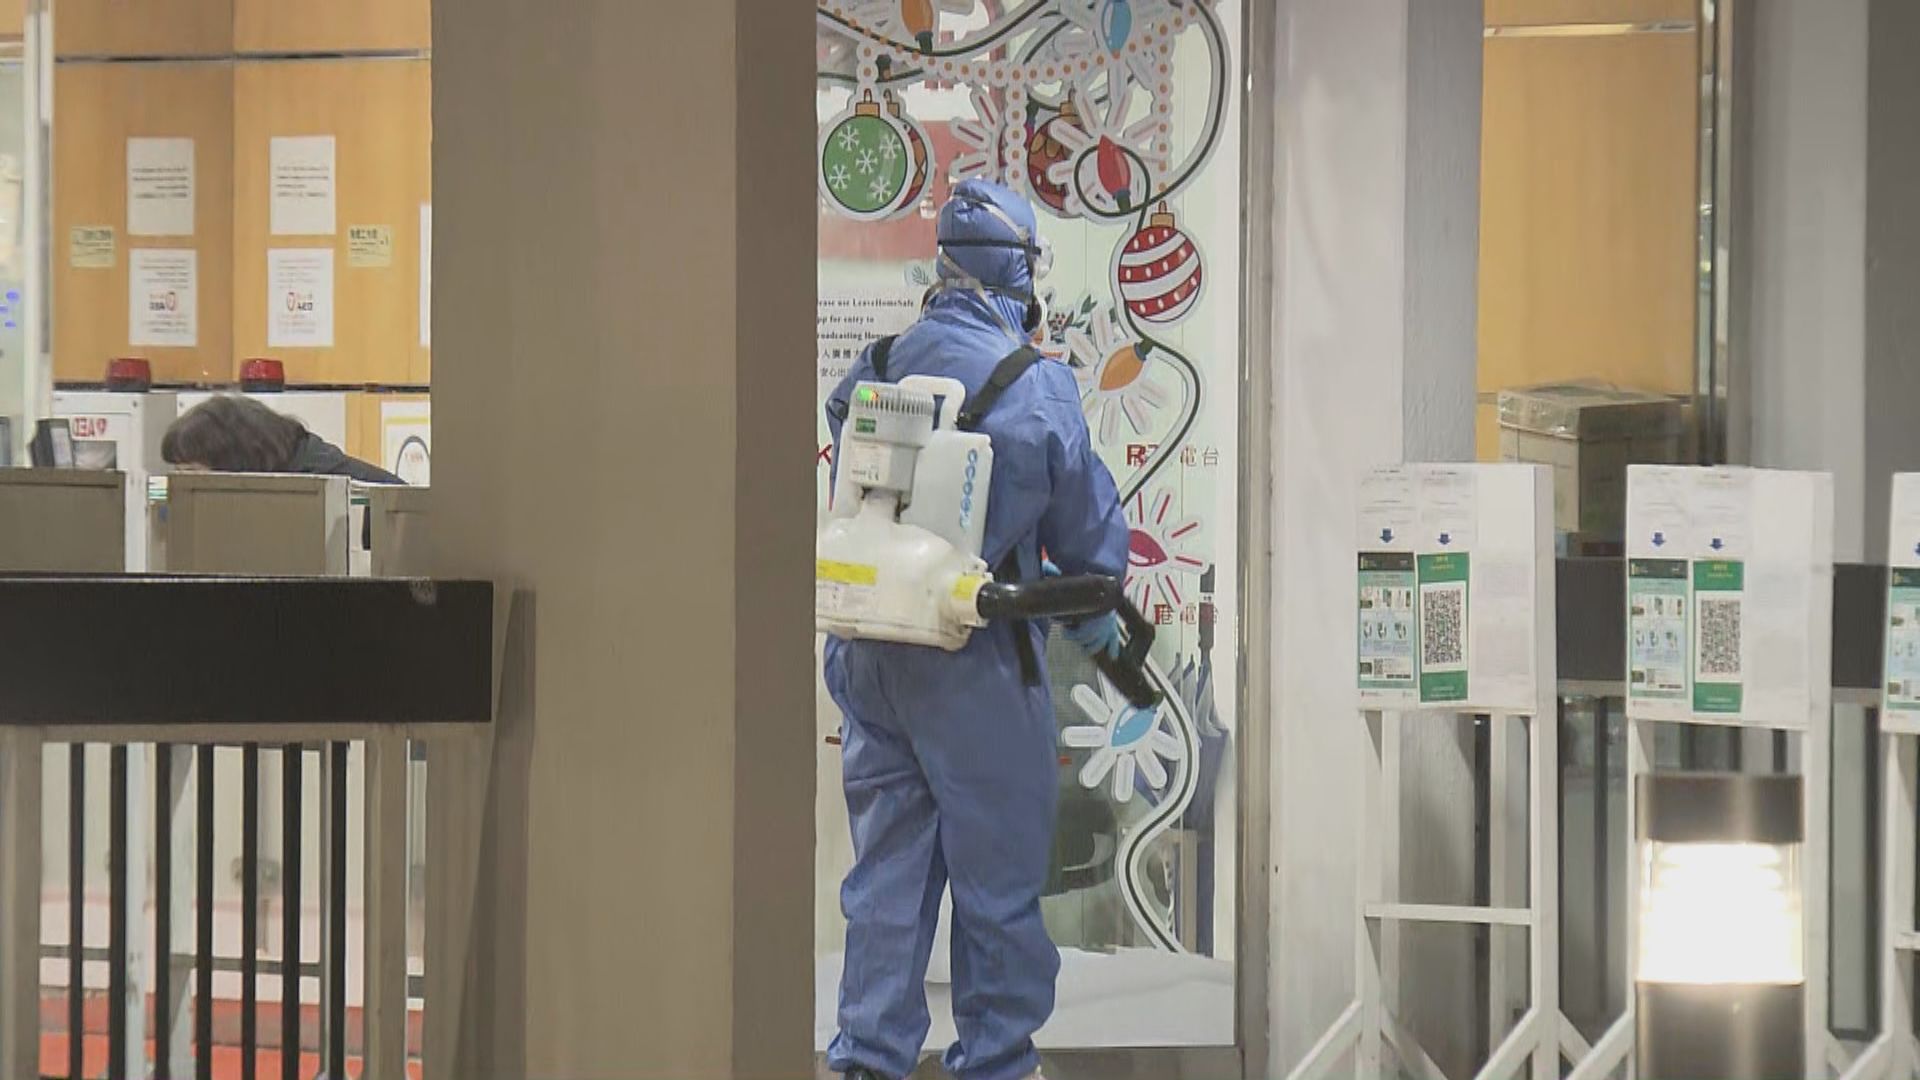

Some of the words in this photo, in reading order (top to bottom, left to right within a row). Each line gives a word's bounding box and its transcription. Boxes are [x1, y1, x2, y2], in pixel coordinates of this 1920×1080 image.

[817, 299, 834, 307] ease
[830, 315, 841, 323] for
[843, 316, 864, 325] entry
